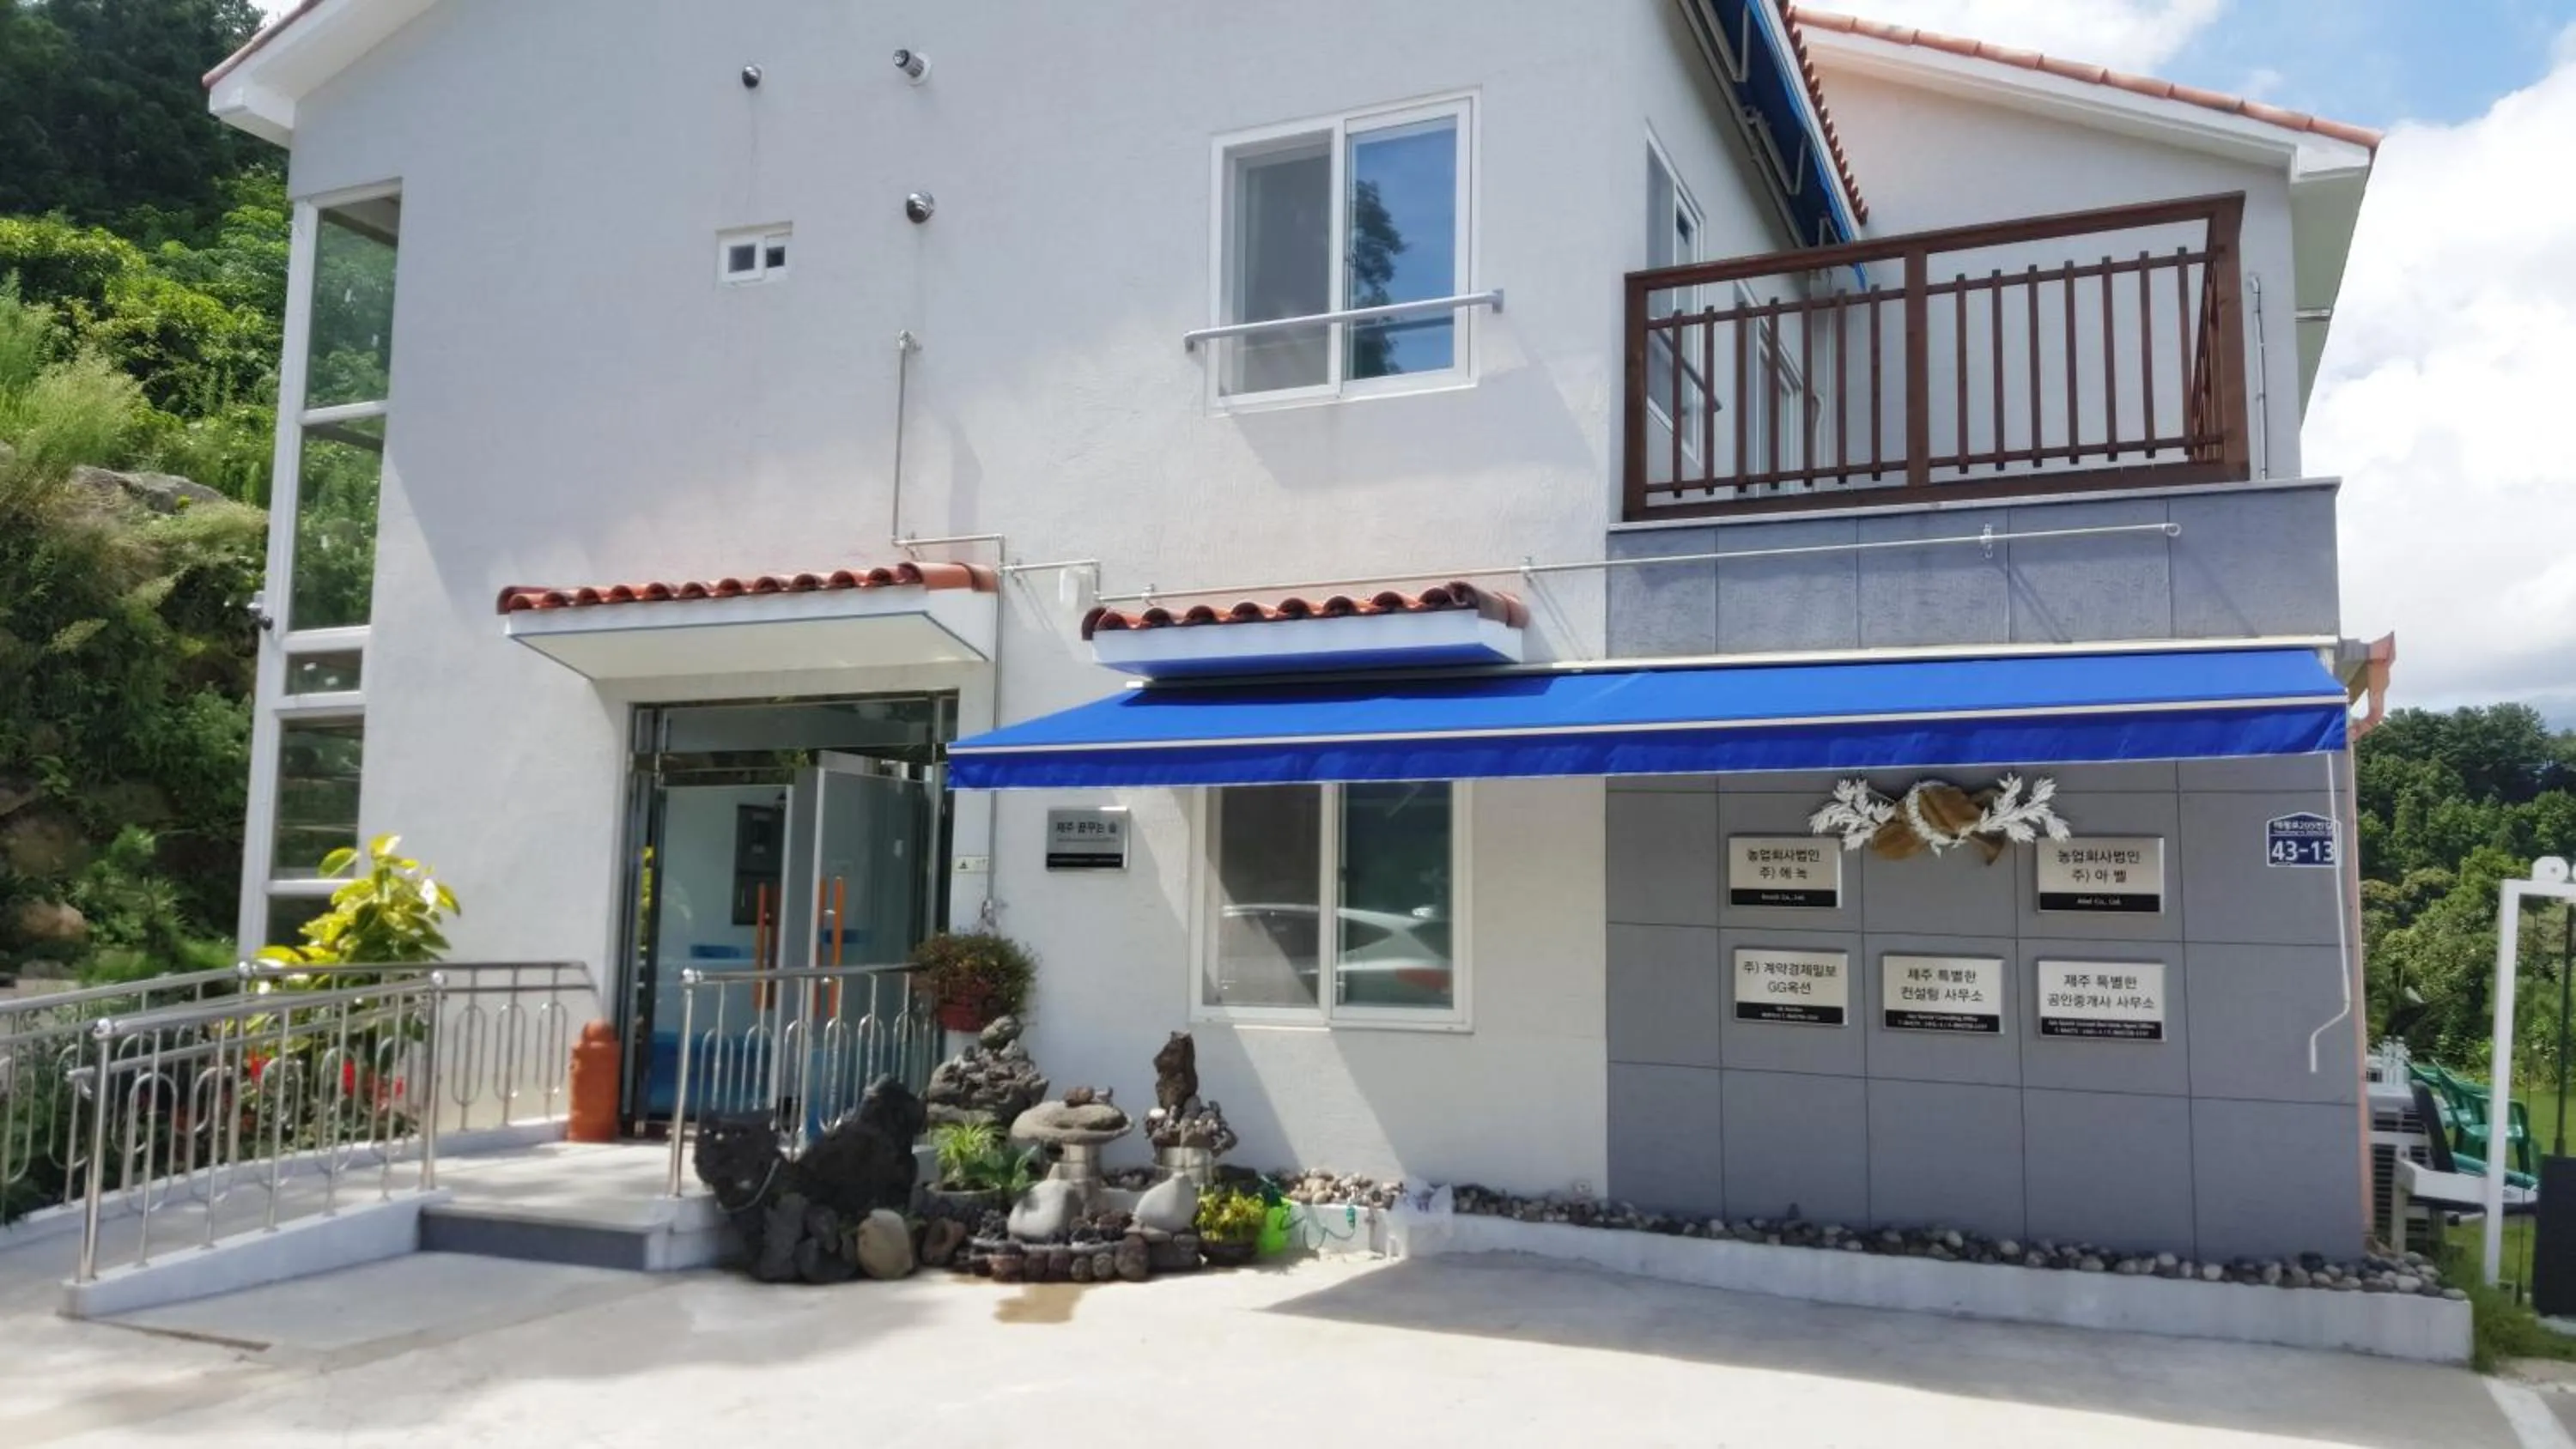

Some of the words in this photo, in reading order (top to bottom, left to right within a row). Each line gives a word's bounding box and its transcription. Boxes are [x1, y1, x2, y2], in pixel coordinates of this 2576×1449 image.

[1747, 848, 1820, 863] 농업회사법인
[2057, 849, 2141, 864] 농업회사법인
[2271, 840, 2335, 861] 43-13
[1937, 968, 1978, 984] 특별한
[2063, 974, 2090, 988] 제주
[2095, 974, 2137, 990] 특별한
[1944, 988, 1983, 1003] 사무소
[2047, 993, 2111, 1008] 공인중개사
[2117, 995, 2154, 1009] 사무소
